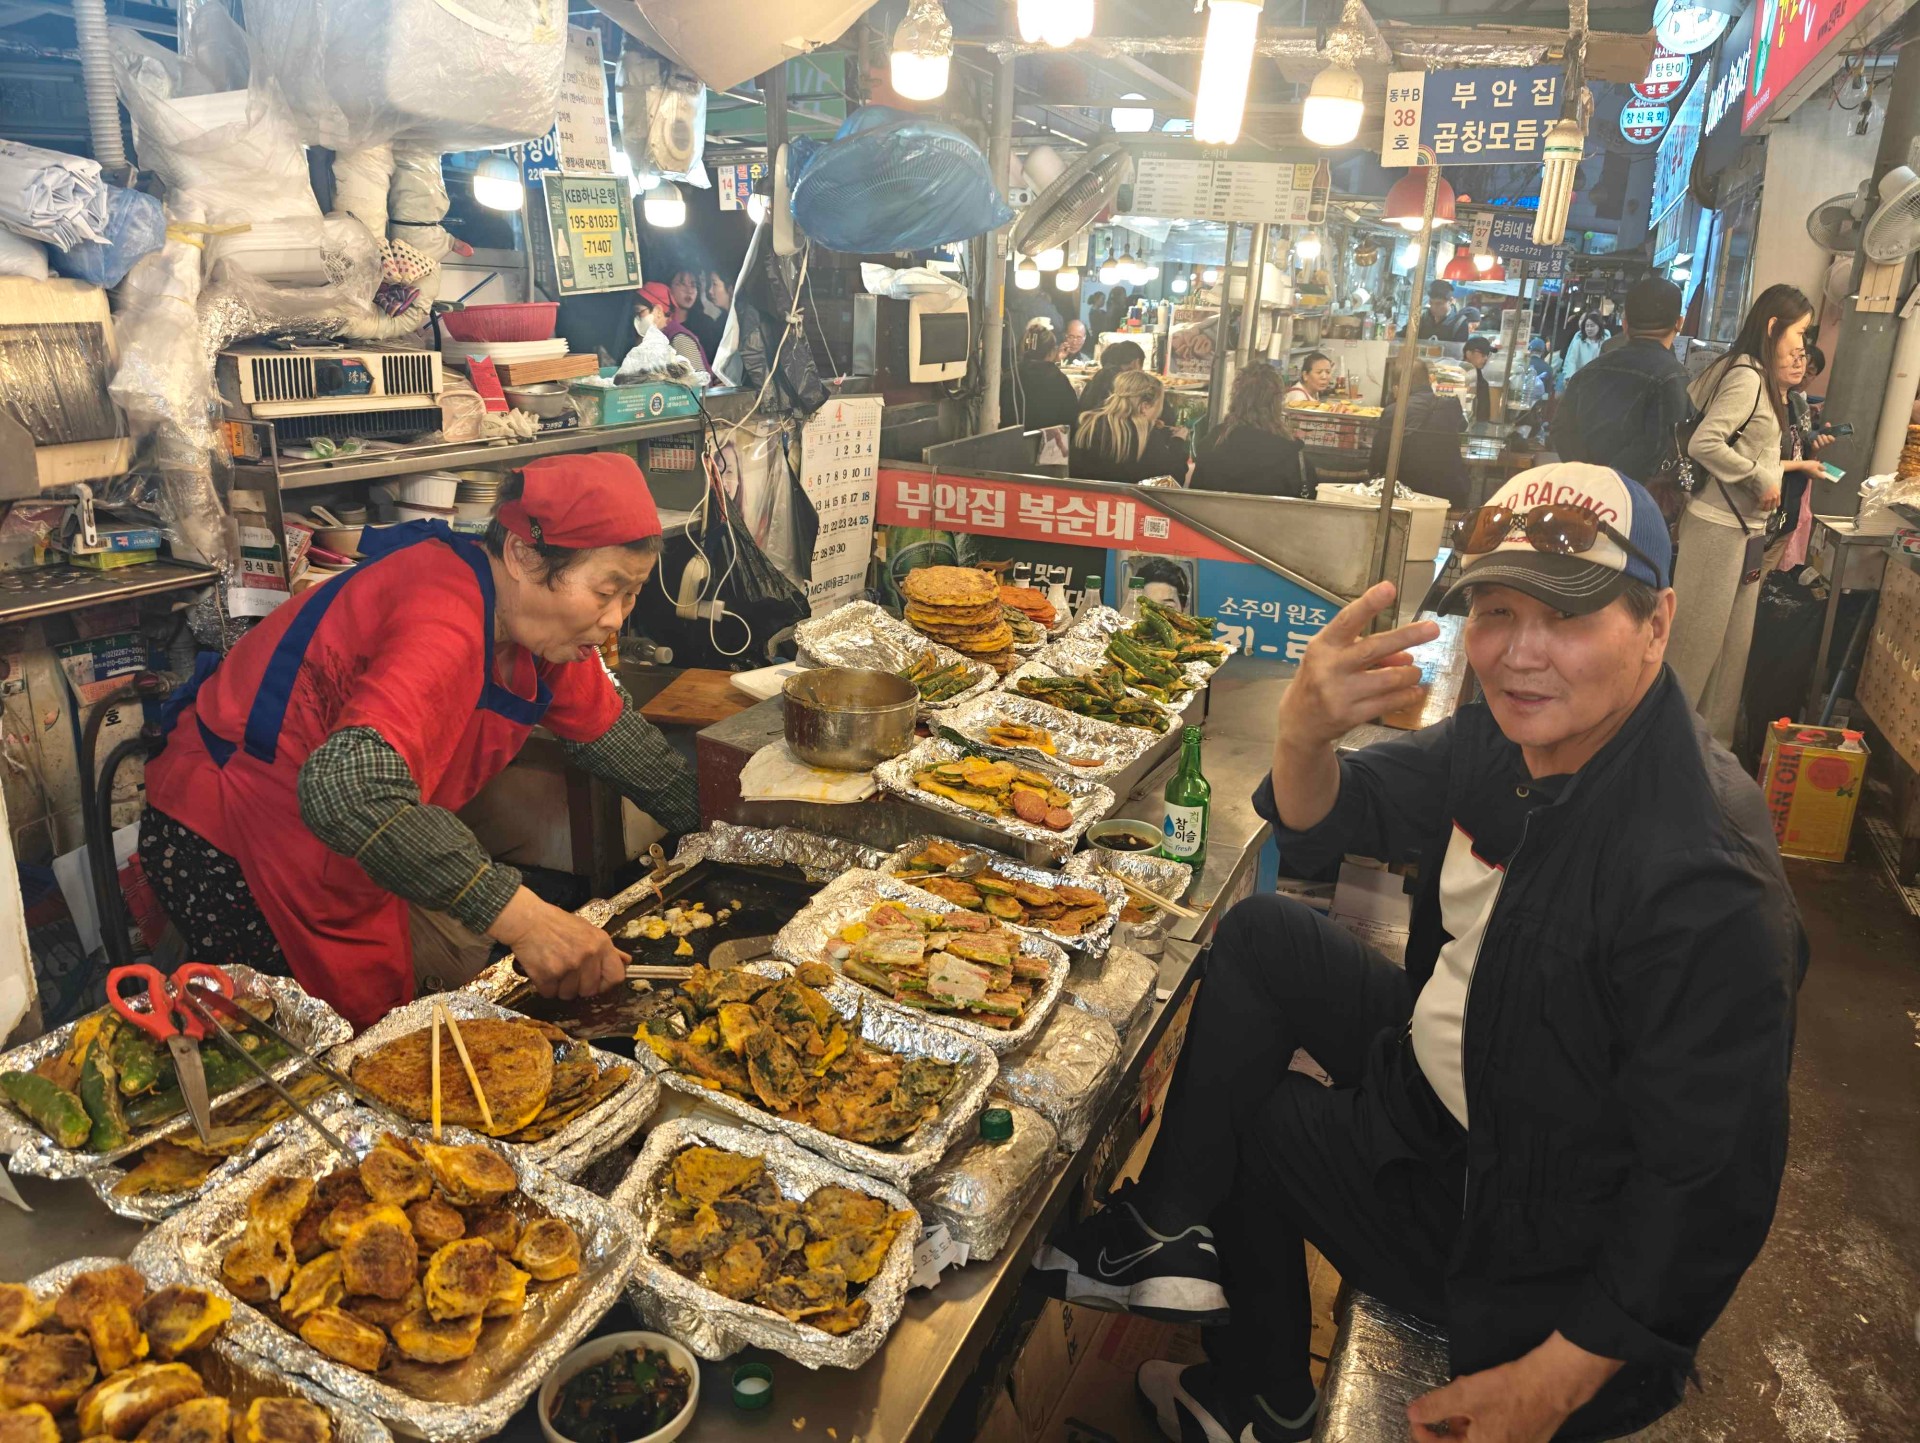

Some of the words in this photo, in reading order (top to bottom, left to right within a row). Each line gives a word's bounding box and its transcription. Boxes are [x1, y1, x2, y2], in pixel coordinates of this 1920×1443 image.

[1655, 61, 1684, 78] 탕탕이
[1389, 88, 1421, 103] 동부B
[1645, 84, 1670, 95] 전문
[1393, 108, 1416, 127] 38
[1626, 110, 1665, 124] 창신육회
[1634, 128, 1653, 137] 전문
[1392, 134, 1410, 150] 호
[721, 178, 733, 190] 14
[565, 187, 617, 205] KEB하나은행
[569, 215, 618, 229] 195-810337
[1493, 219, 1524, 239] 명희네
[1475, 228, 1488, 237] 37
[583, 240, 612, 254] -71407
[1499, 243, 1541, 257] 2266-1721
[588, 262, 614, 279] 박주영
[835, 404, 842, 422] 4
[835, 447, 839, 457] 1
[844, 444, 849, 455] 2
[855, 444, 861, 454] 3
[866, 443, 872, 453] 4
[808, 476, 813, 487] 5
[817, 474, 822, 486] 6
[826, 473, 831, 483] 7
[834, 471, 839, 481] 8
[842, 469, 848, 480] 9
[852, 467, 861, 478] 10
[864, 467, 871, 477] 11
[815, 500, 822, 511] 13
[824, 498, 830, 509] 14
[832, 496, 839, 507] 15
[840, 494, 847, 505] 16
[850, 492, 859, 503] 17
[862, 491, 870, 501] 18
[1523, 481, 1618, 525] RACING
[895, 480, 1006, 529] 부안집
[1017, 493, 1136, 541] 복순네
[822, 523, 829, 534] 21
[830, 521, 838, 531] 22
[838, 518, 847, 529] 23
[848, 516, 858, 527] 24
[859, 515, 869, 525] 25
[812, 551, 820, 562] 27
[820, 548, 828, 559] 28
[829, 546, 836, 556] 29
[836, 543, 846, 553] 30
[810, 574, 850, 596] MG새마을금고
[1218, 596, 1281, 623] 소주의
[1285, 604, 1328, 627] 원조
[105, 709, 122, 727] 호
[1775, 751, 1801, 785] OIL
[1175, 817, 1188, 831] 참
[1175, 830, 1197, 843] 이슬
[1175, 844, 1193, 852] fresh
